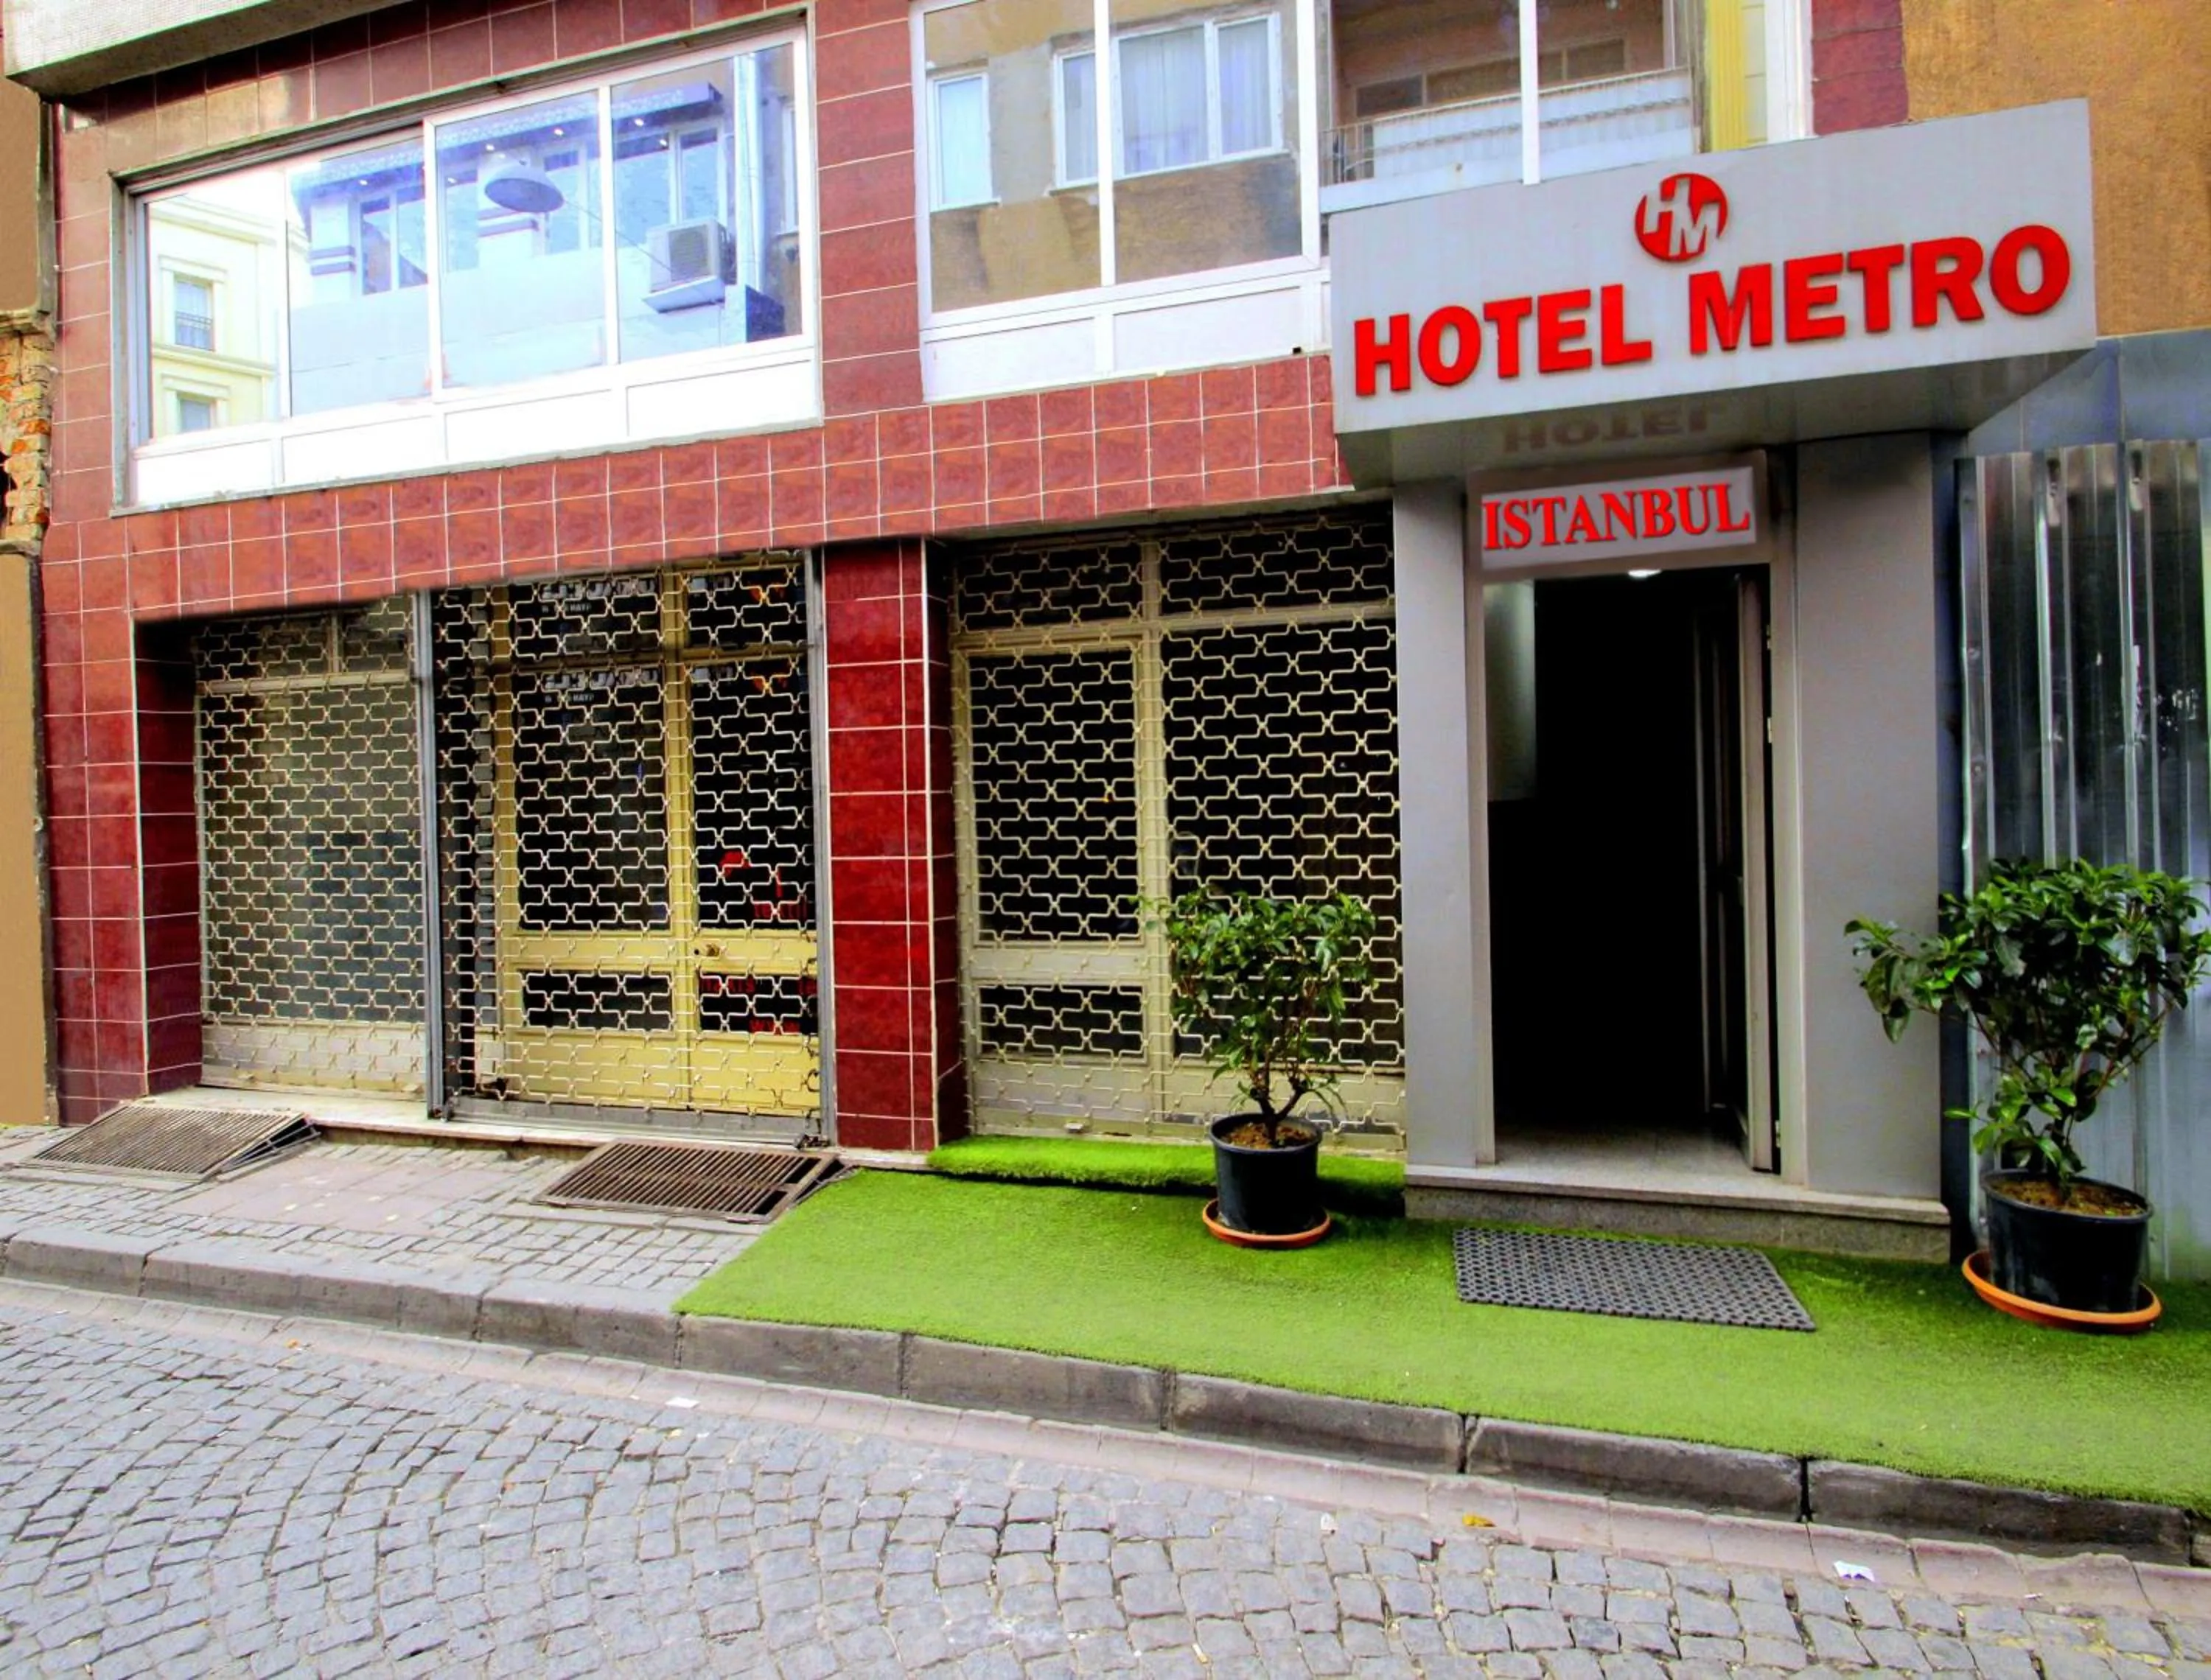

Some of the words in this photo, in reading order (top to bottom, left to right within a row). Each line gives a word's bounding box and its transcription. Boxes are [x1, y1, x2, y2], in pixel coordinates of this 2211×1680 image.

[1354, 284, 1653, 397] HOTEL
[1688, 224, 2072, 355] METRO
[1481, 482, 1751, 551] ISTANBUL
